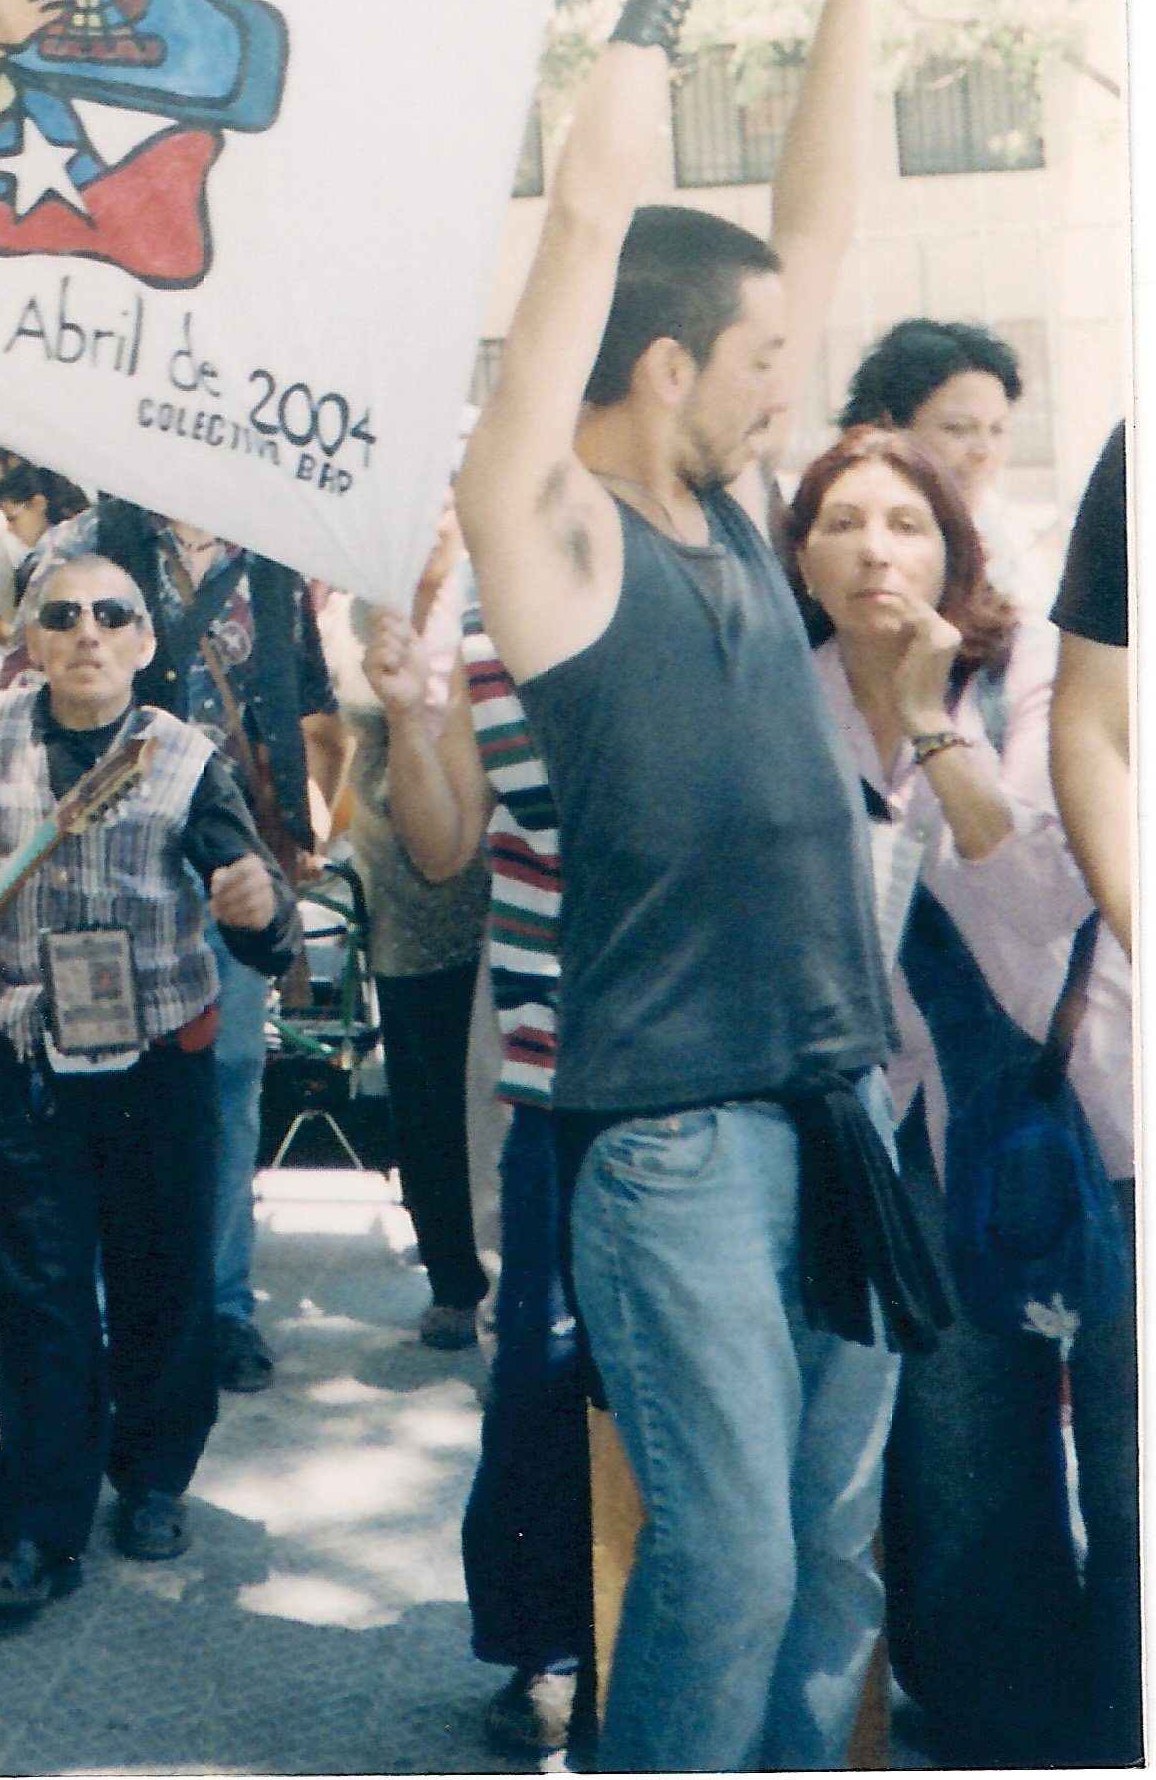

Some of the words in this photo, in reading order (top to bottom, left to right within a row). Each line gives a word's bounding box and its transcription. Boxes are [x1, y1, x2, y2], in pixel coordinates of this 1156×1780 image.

[4, 276, 144, 376] Abril
[169, 311, 222, 398] de
[248, 369, 377, 468] 2004
